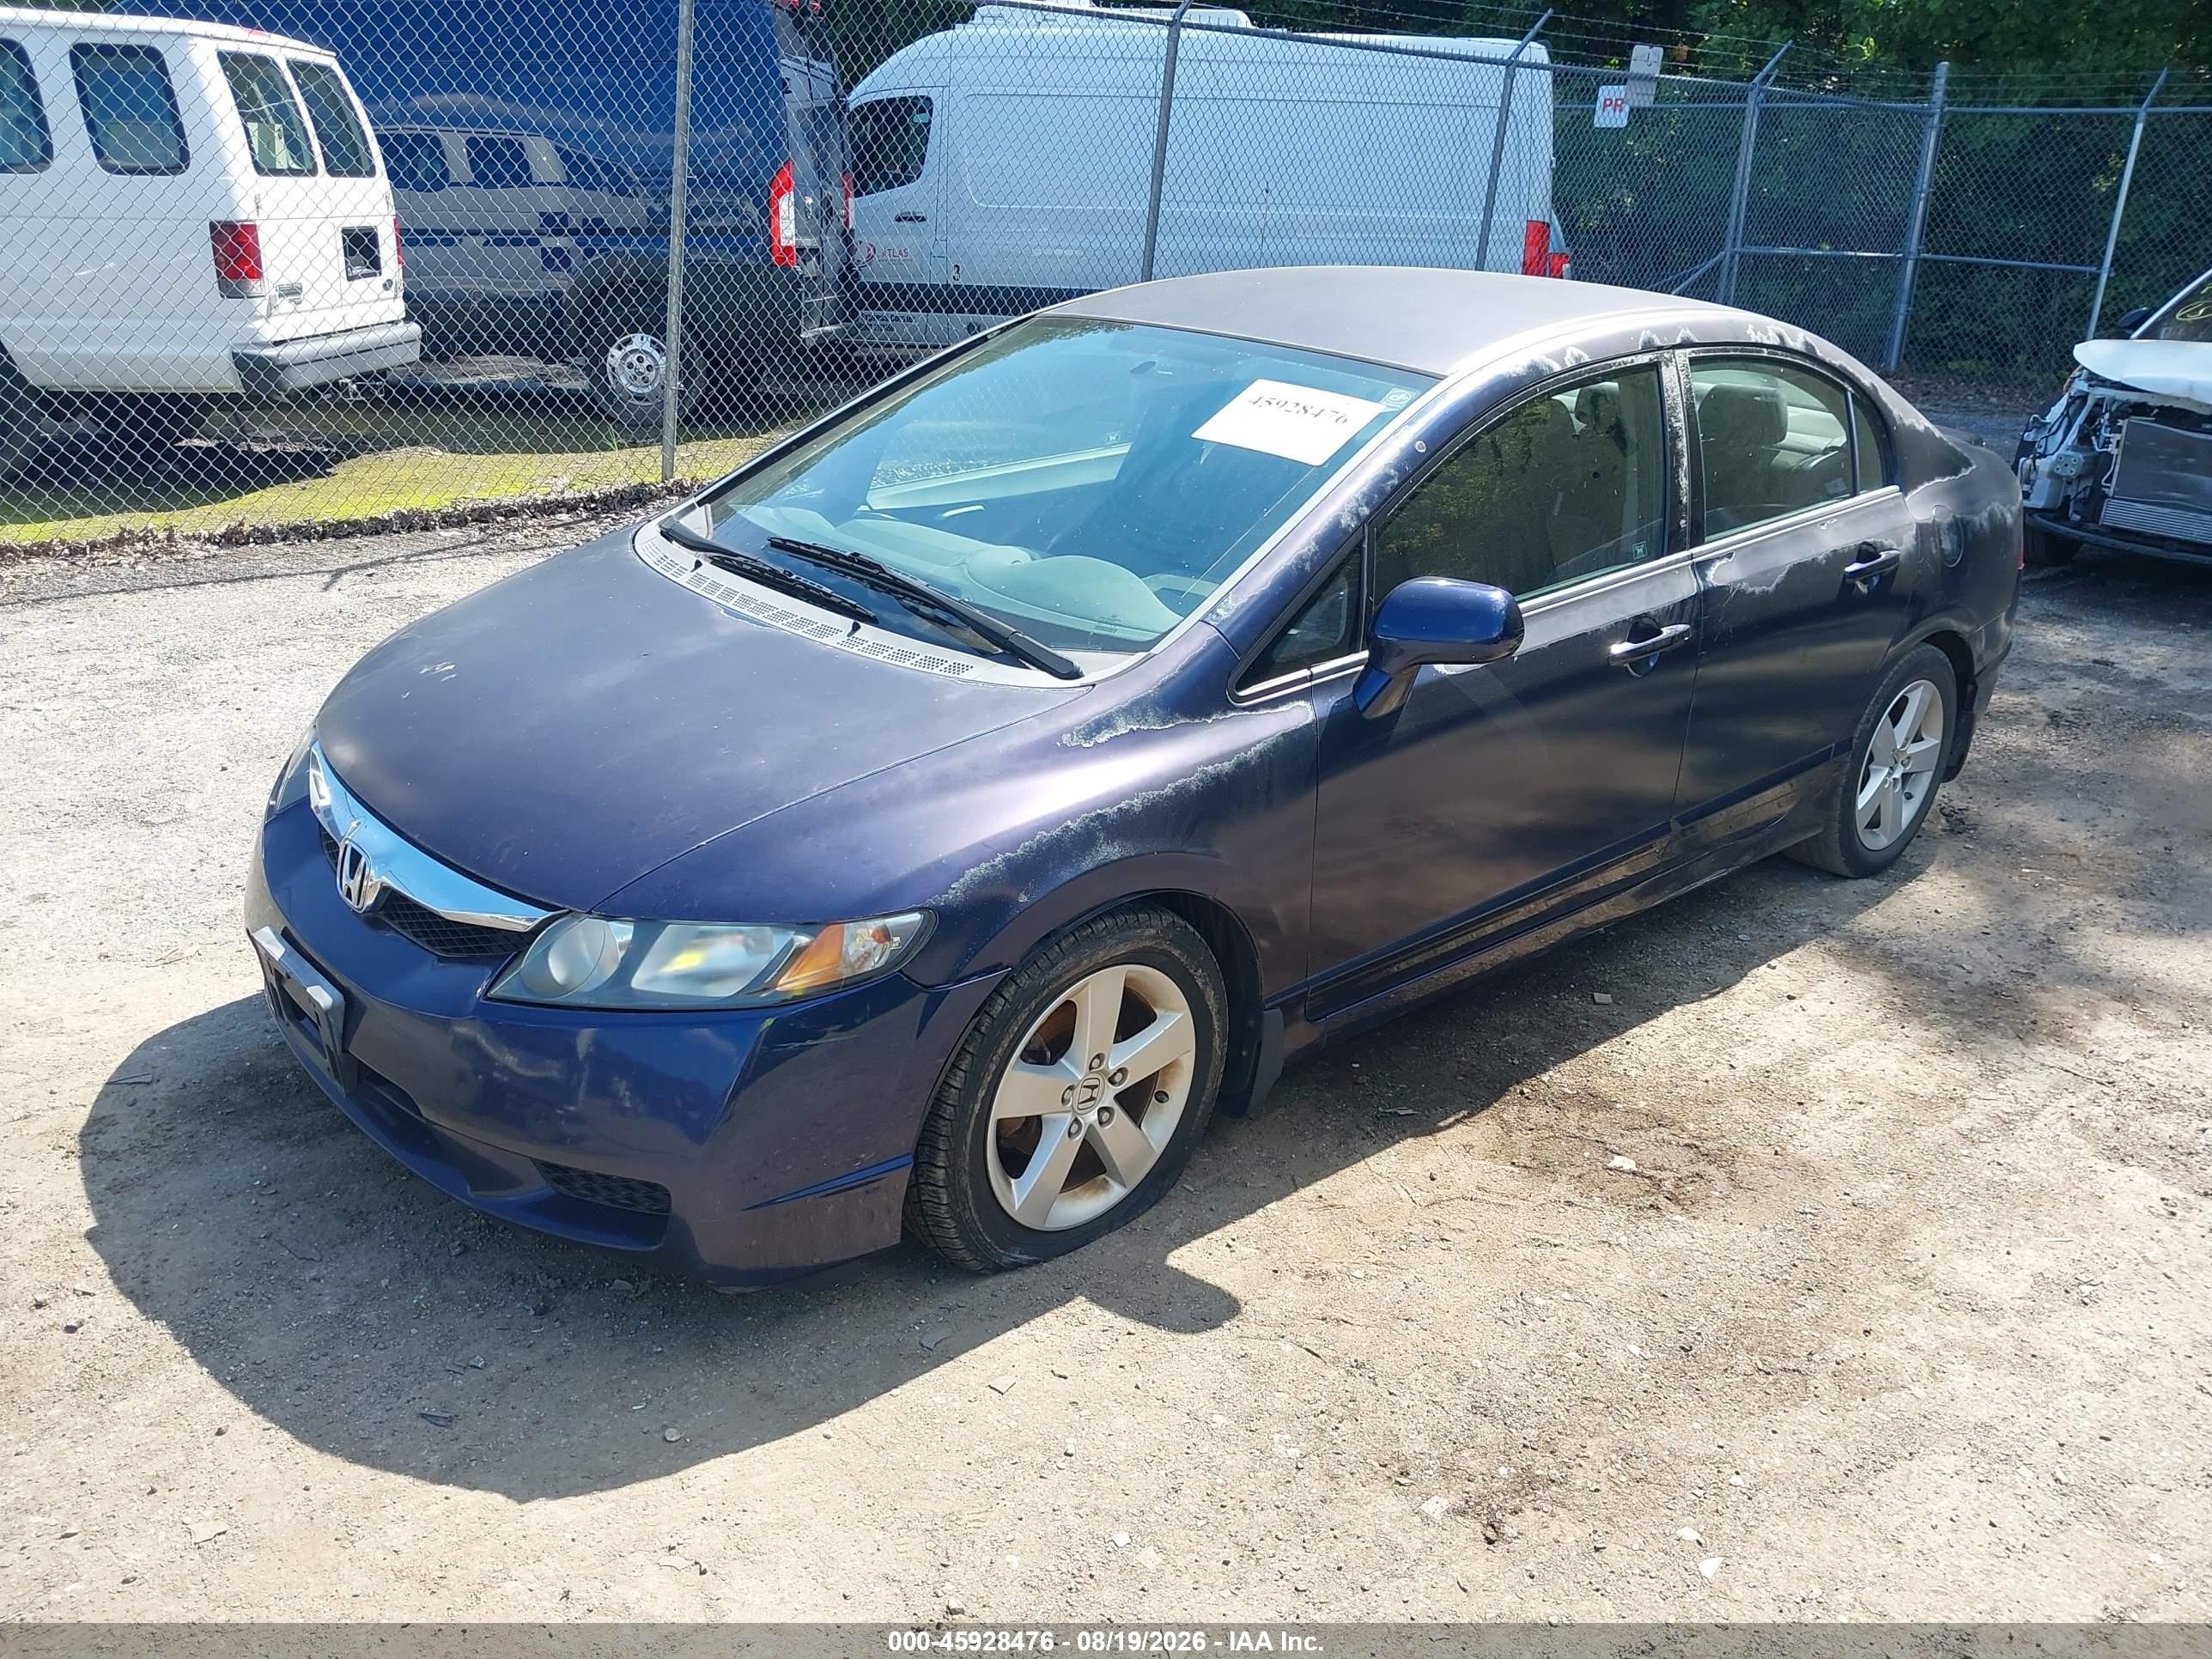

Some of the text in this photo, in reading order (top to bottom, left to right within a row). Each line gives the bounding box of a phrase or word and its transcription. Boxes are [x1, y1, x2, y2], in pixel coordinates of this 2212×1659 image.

[881, 247, 909, 258] ATLAS
[952, 264, 962, 282] 3
[1248, 395, 1349, 425] 45928476
